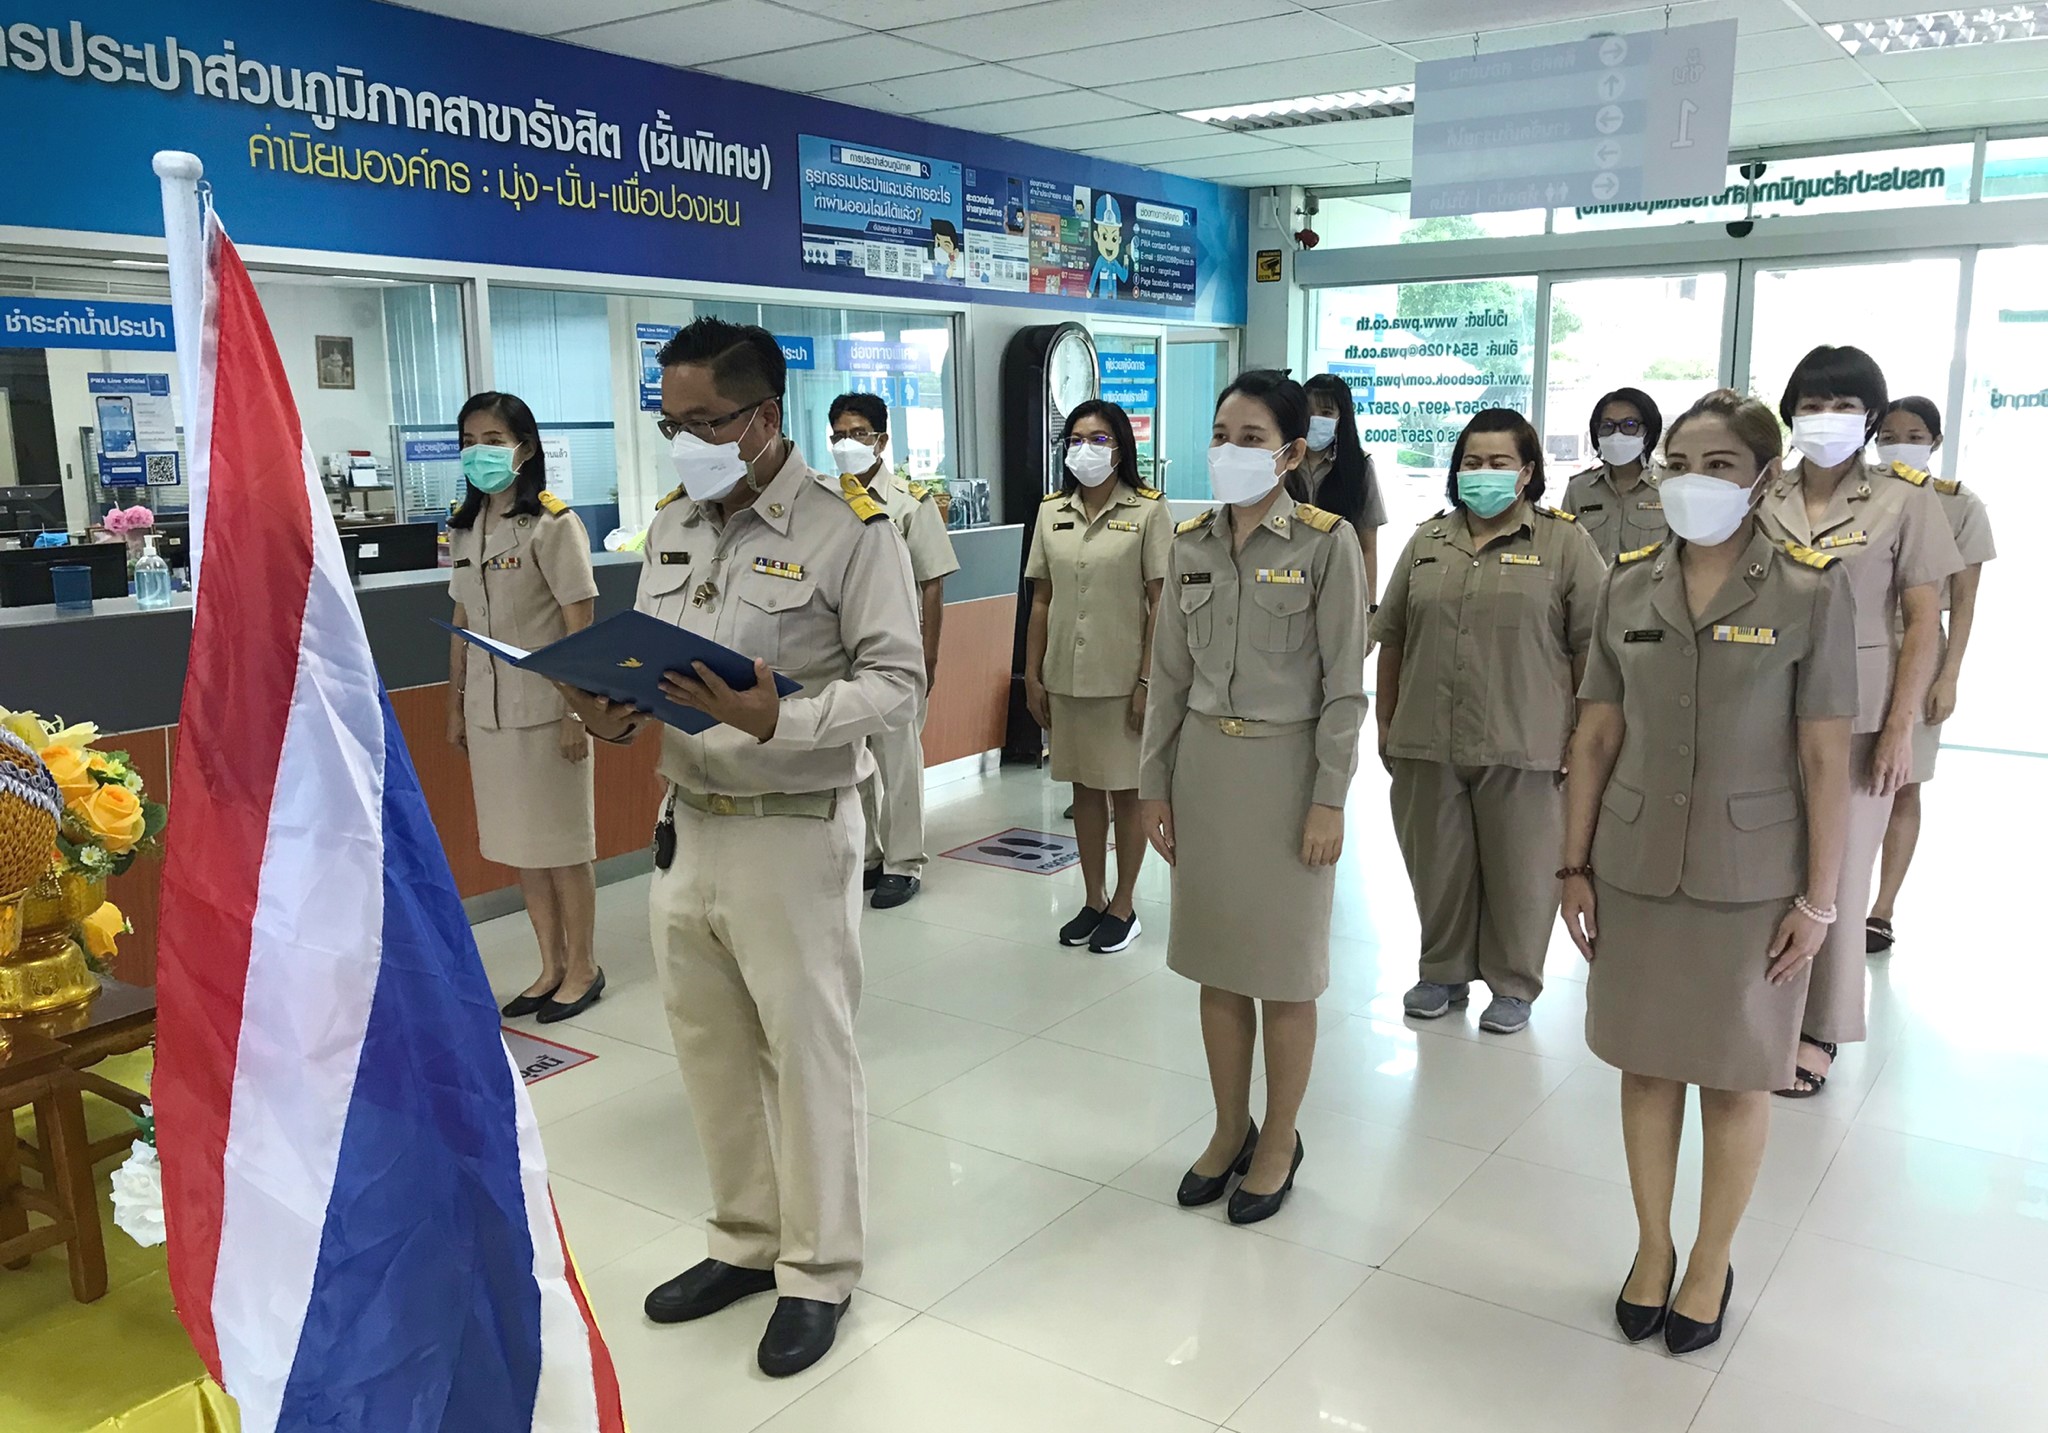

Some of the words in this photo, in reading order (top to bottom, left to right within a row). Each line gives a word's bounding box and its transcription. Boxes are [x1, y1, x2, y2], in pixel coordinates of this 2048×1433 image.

[638, 109, 771, 190] (ชั้นพิเศษ)
[249, 123, 470, 193] ค่านิยมองค์กร
[499, 163, 740, 227] มุ่ง-มั่น-เพื่อปวงชน
[805, 168, 951, 204] ธุรกรรมประปาและบริการอะไร
[1031, 240, 1039, 248] 04
[5, 307, 166, 338] ชำระค่าน้ำประปา
